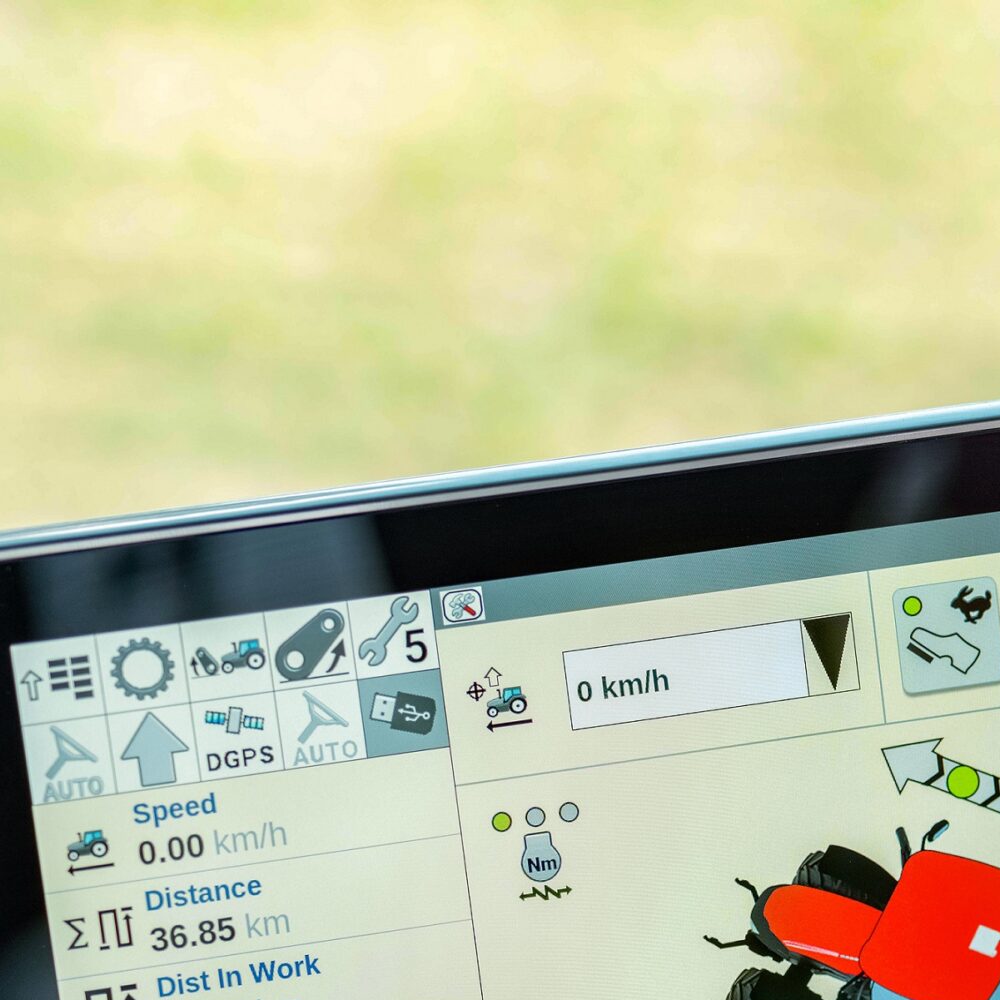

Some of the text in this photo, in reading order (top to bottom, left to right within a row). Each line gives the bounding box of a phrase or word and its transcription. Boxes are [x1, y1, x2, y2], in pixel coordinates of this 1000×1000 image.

[405, 628, 428, 664] 5
[577, 668, 670, 702] 0 km/h
[206, 746, 275, 772] DGPS
[293, 740, 358, 767] AUTO
[43, 775, 104, 802] AUTO
[133, 793, 217, 828] Speed
[139, 821, 288, 866] 0.00 km/h
[527, 857, 557, 873] Nm
[144, 877, 262, 911] Distance
[150, 912, 291, 952] 36.85 km
[157, 954, 321, 998] Dist In Work
